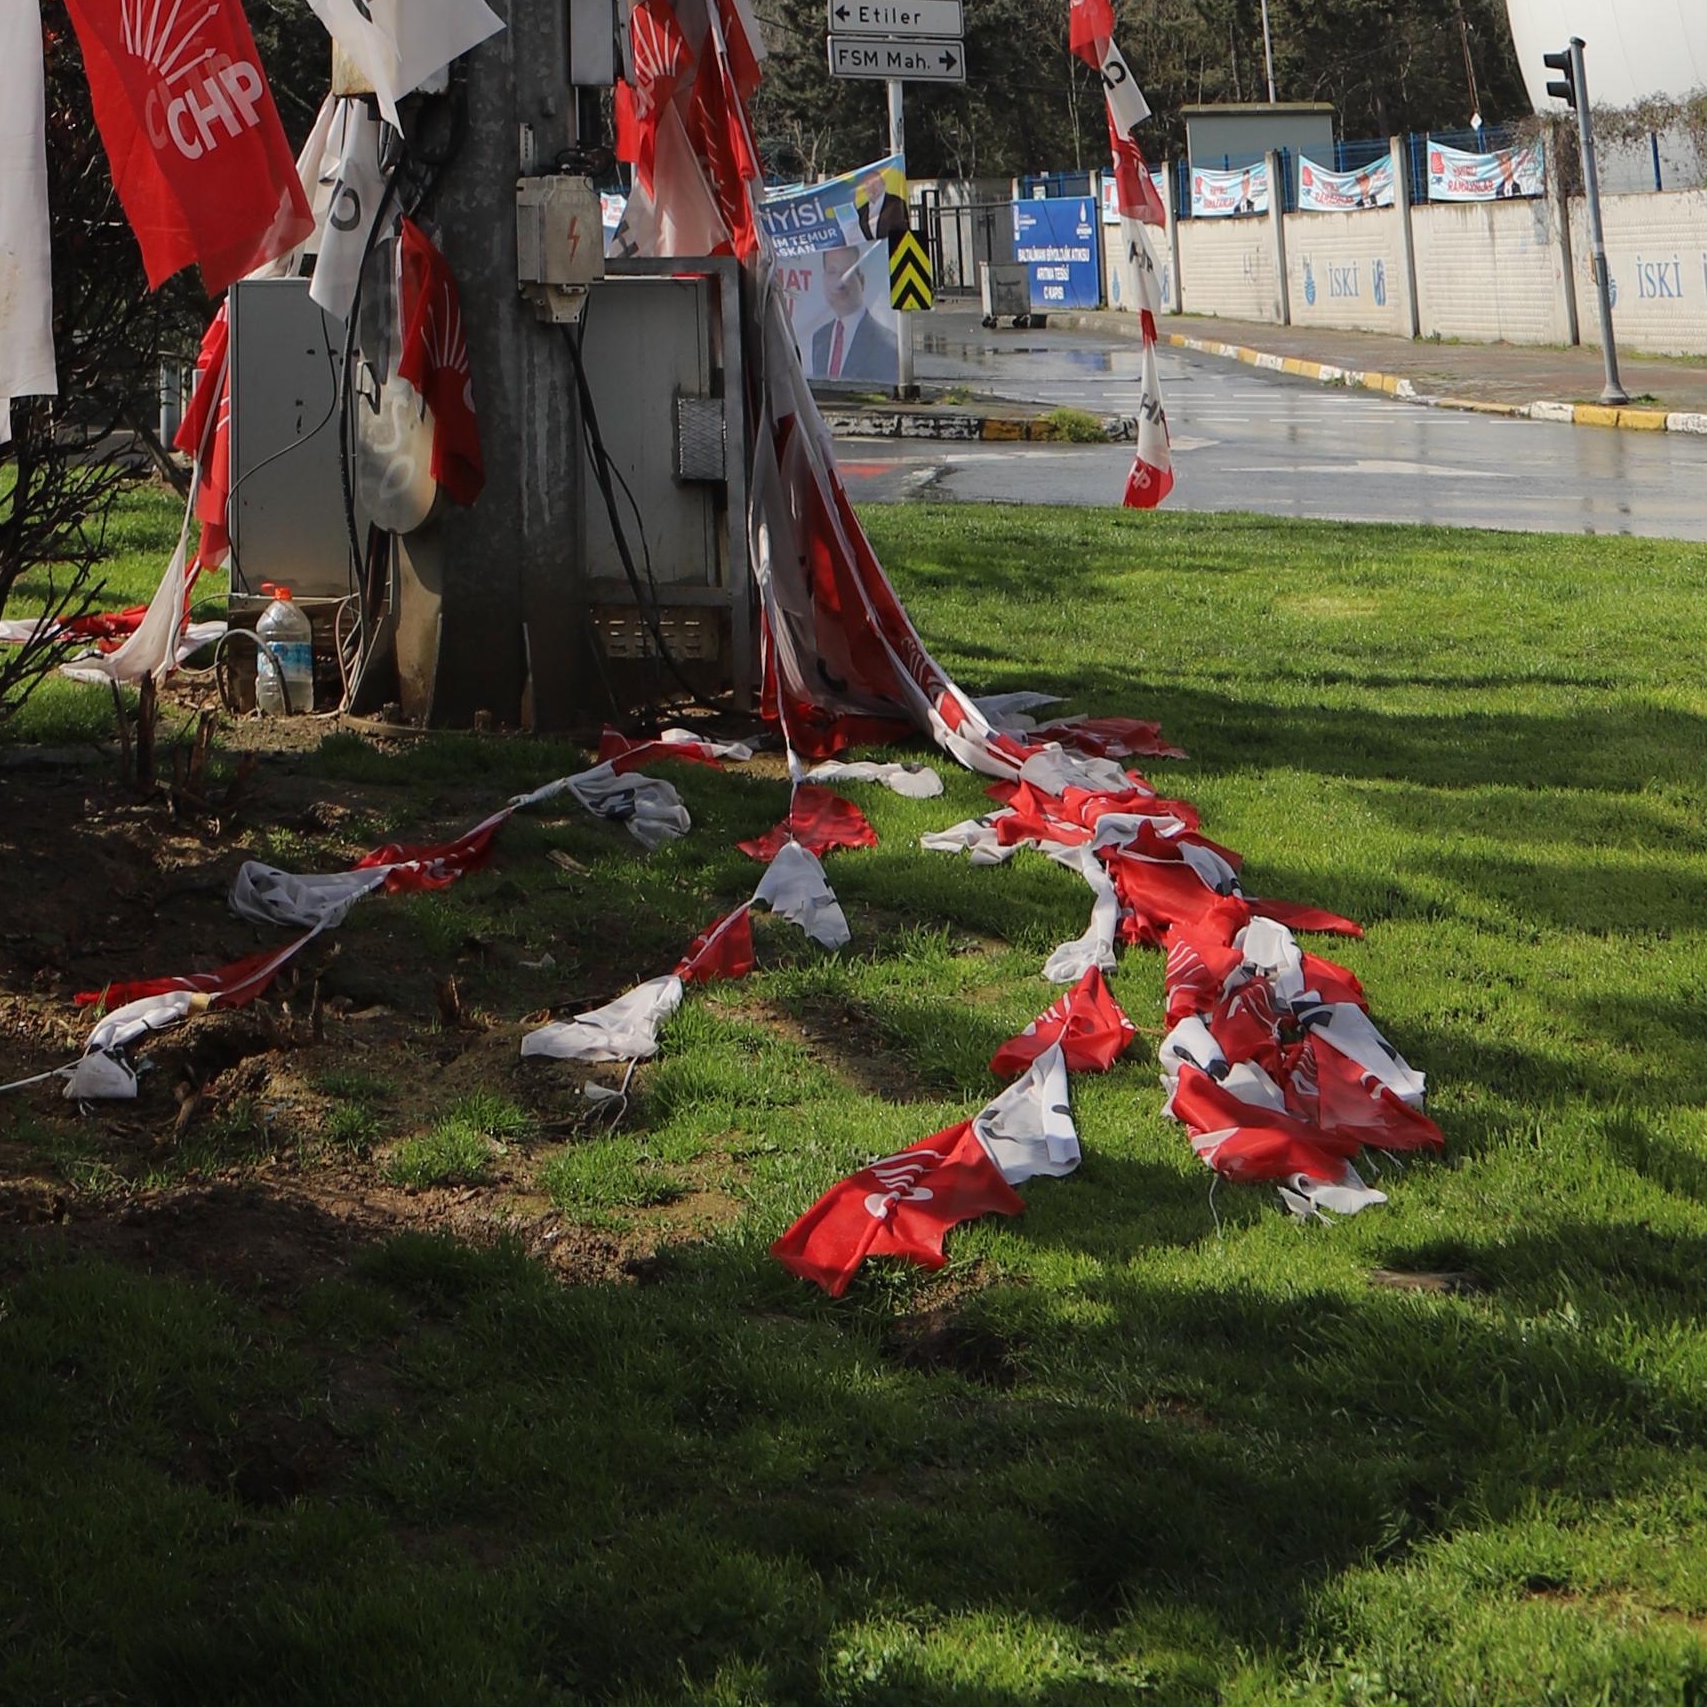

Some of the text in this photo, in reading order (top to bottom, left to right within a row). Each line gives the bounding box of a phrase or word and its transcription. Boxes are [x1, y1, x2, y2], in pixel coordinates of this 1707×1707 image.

[859, 6, 921, 24] Etiler
[838, 49, 931, 70] FSM Mah.
[166, 57, 265, 161] CHP
[791, 227, 838, 246] TEMUR
[1329, 261, 1359, 297] İSKİ
[1637, 253, 1683, 299] İSKİ
